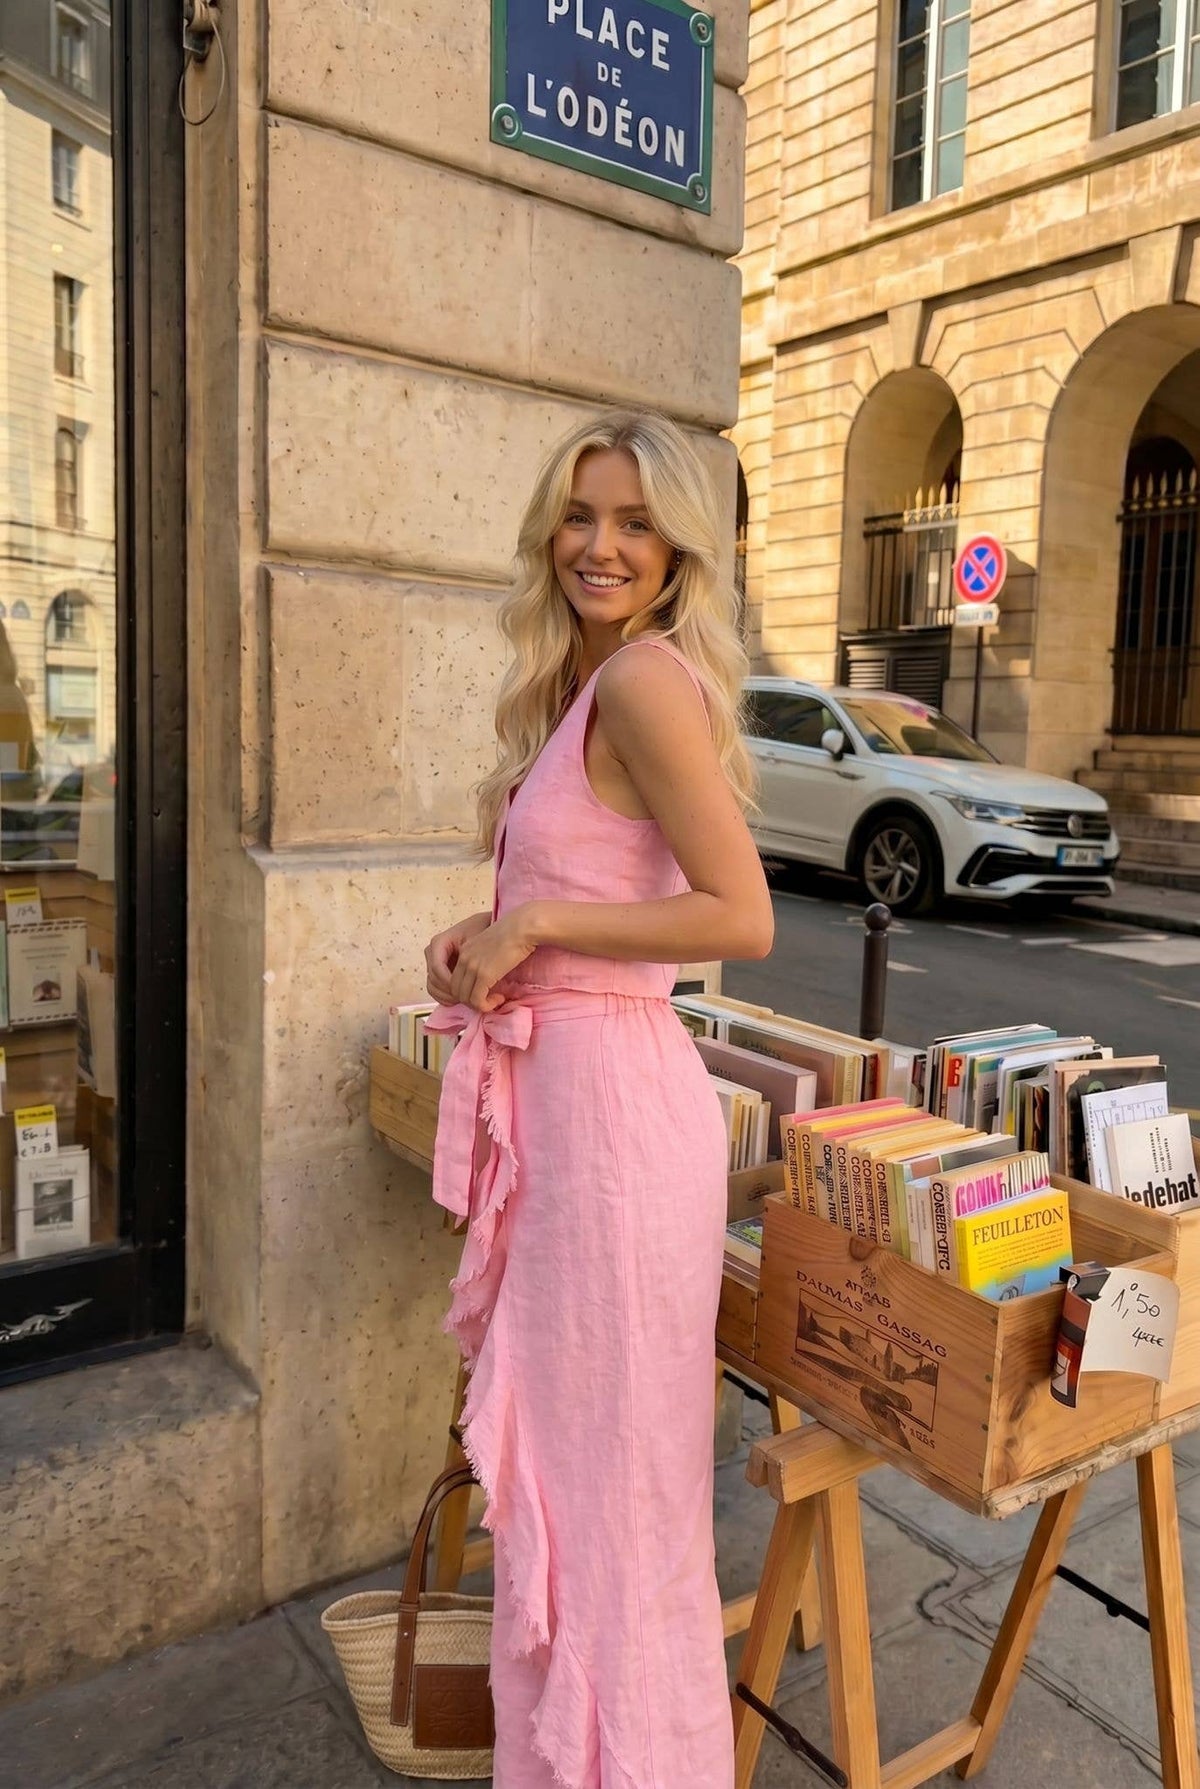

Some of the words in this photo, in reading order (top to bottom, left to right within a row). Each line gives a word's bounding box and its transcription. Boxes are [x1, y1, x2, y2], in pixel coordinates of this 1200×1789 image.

[547, 0, 670, 71] PLACE
[597, 62, 622, 88] DE
[527, 72, 685, 168] L'ODÉON
[973, 1206, 1063, 1246] FEUILLETON
[796, 1270, 863, 1313] DAUMAS
